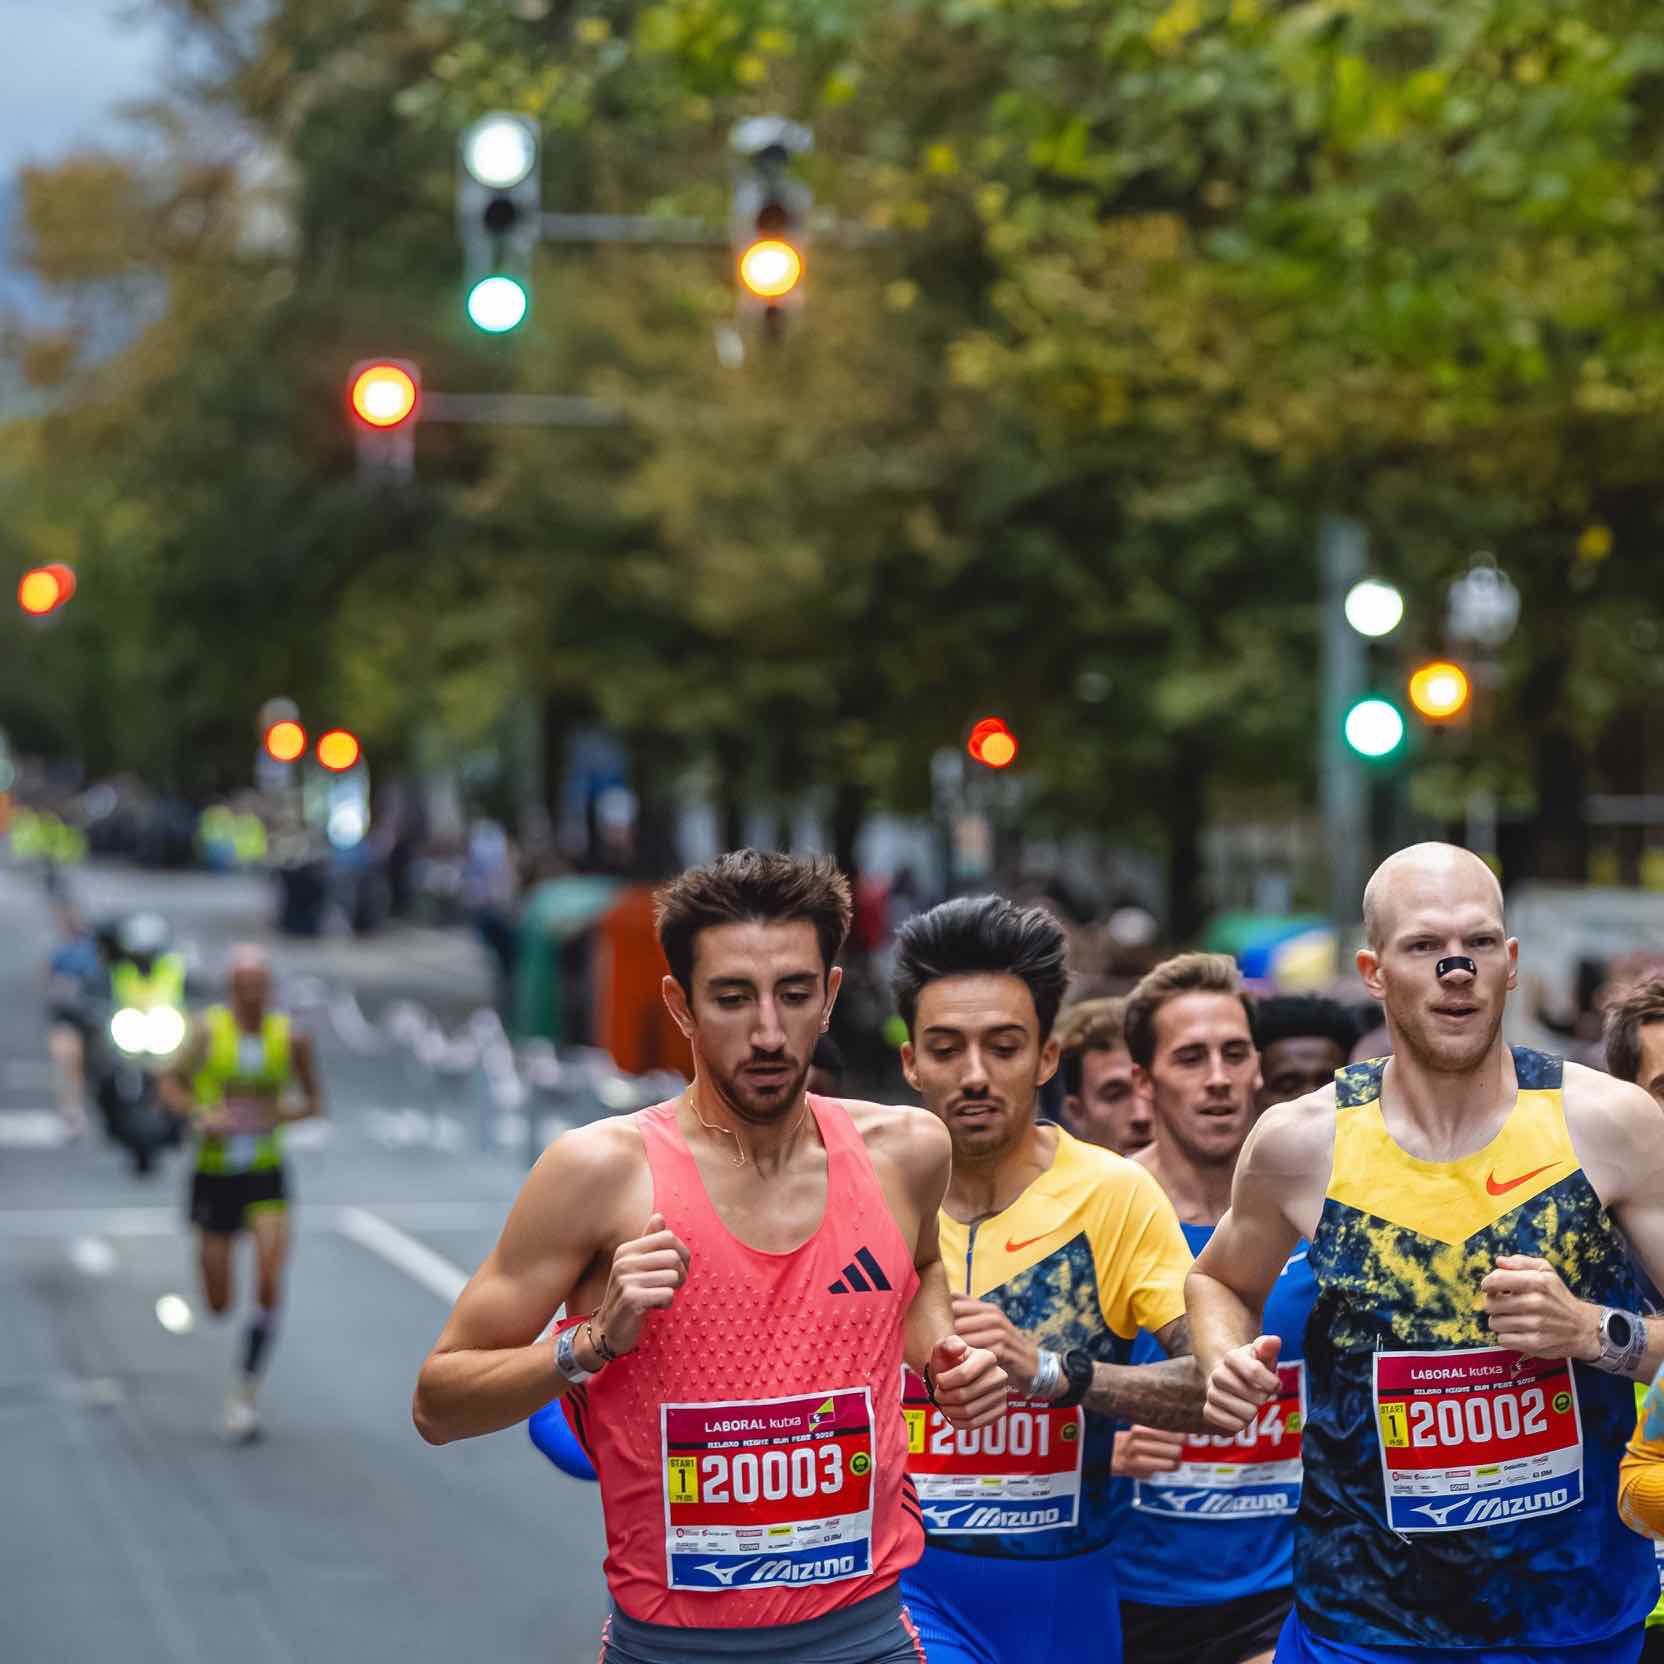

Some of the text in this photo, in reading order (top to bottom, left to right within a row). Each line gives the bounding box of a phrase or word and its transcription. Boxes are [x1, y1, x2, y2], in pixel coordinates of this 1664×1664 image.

[1410, 1367, 1467, 1381] LABORAL
[704, 1413, 802, 1434] LABORAL kutxa
[1388, 1415, 1398, 1438] 1
[1409, 1388, 1548, 1448] 20002
[678, 1469, 687, 1493] 1
[702, 1443, 844, 1504] 20003
